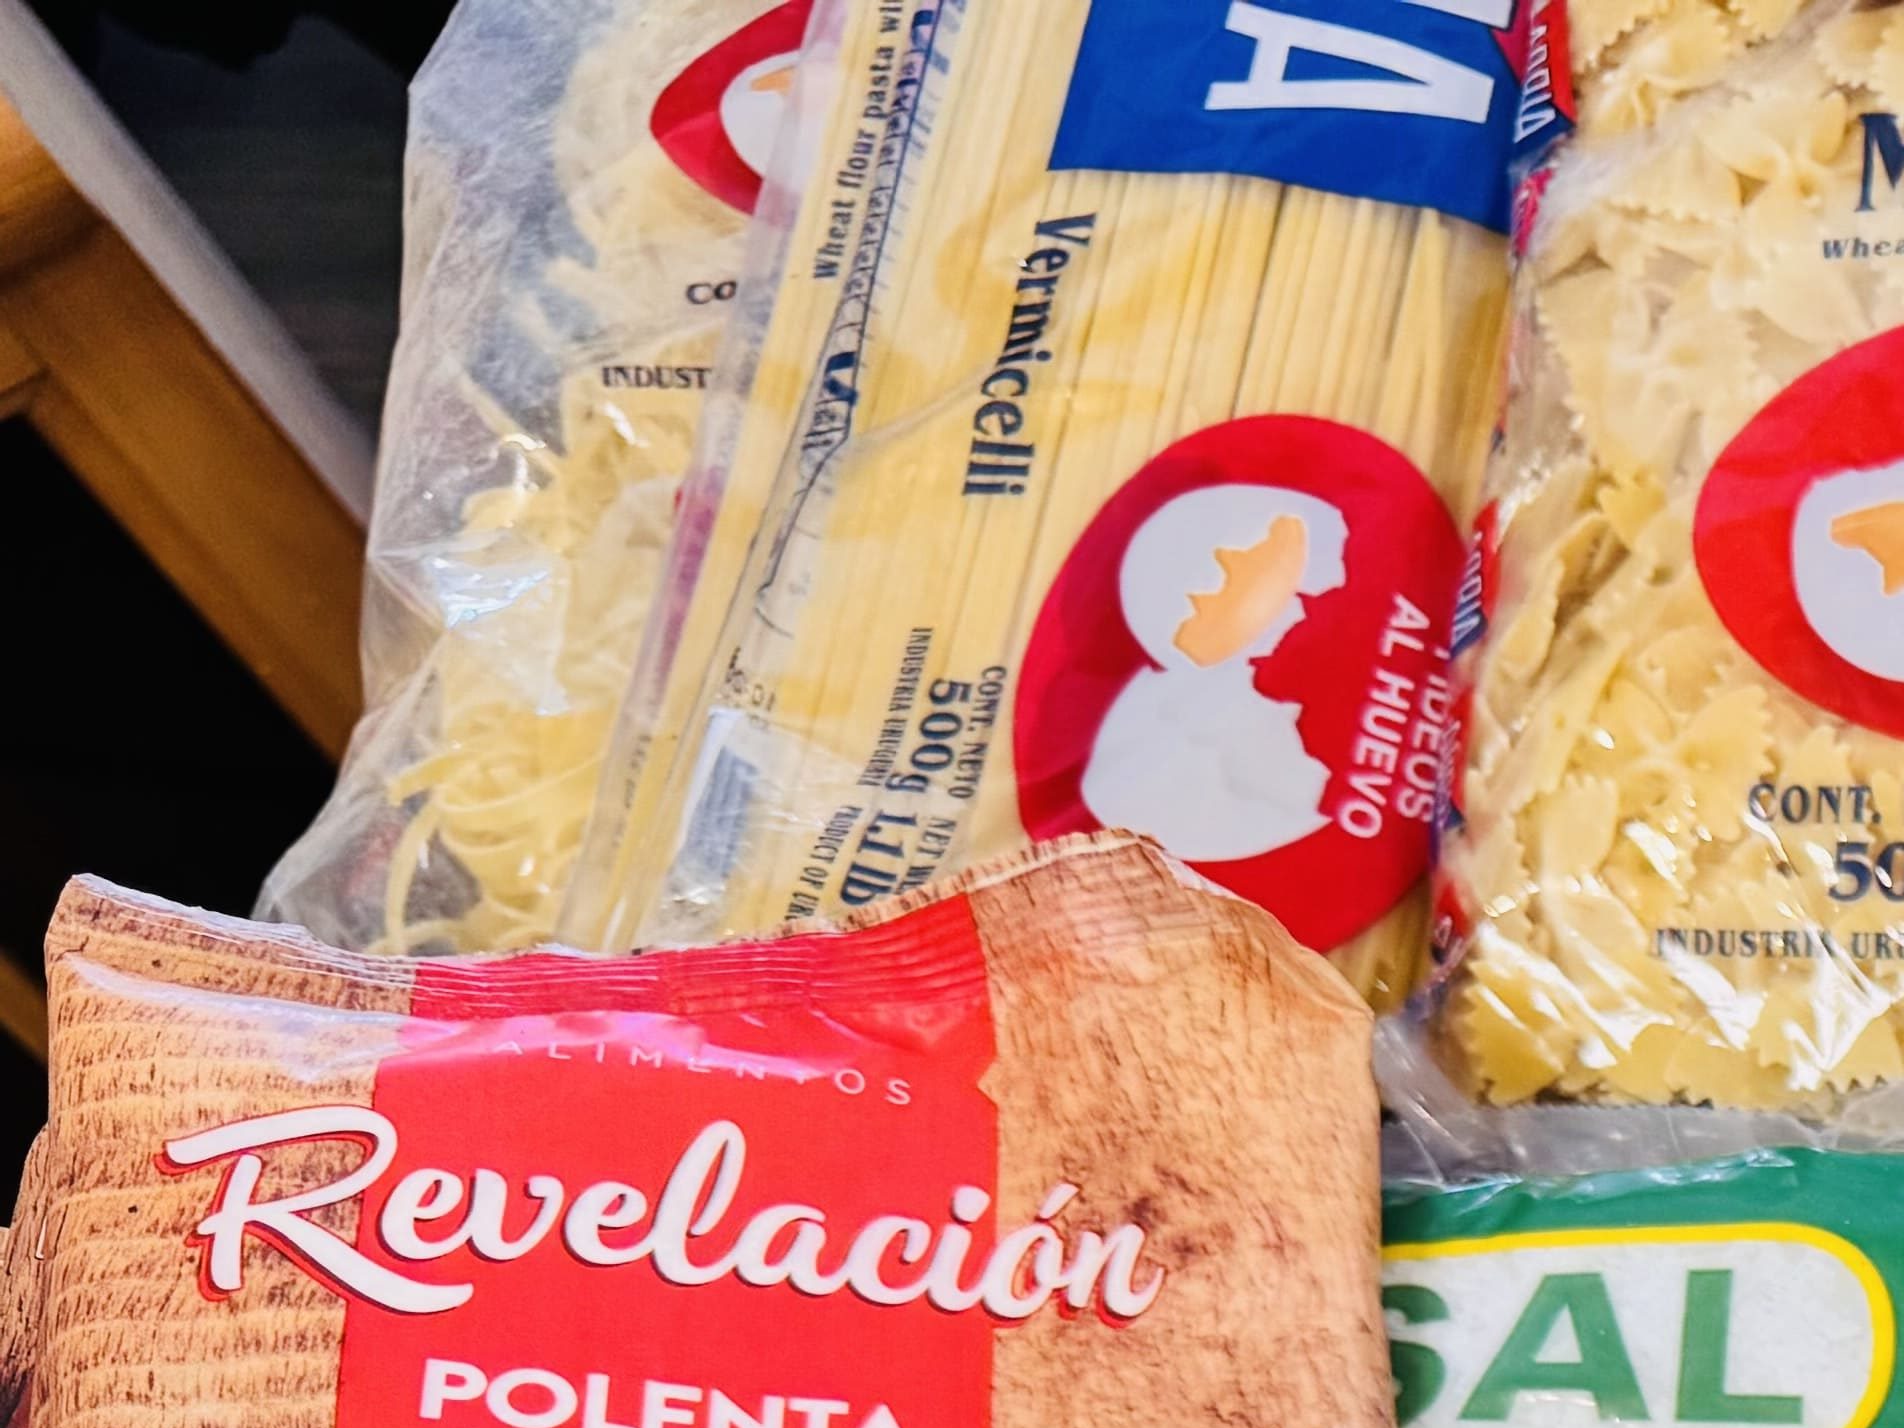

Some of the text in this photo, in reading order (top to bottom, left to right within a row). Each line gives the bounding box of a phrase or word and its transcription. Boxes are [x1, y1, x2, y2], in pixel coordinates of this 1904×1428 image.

[814, 200, 856, 279] Wheat
[837, 129, 876, 189] flour
[864, 46, 898, 119] pasta
[961, 210, 1098, 500] Vermicelli
[889, 627, 932, 713] INDUSTRIA
[967, 665, 1007, 732] CONT.
[885, 678, 972, 793] 500g
[1336, 592, 1431, 839] AL HUEVO
[948, 742, 988, 799] NETO
[811, 805, 863, 862] PRODUCT
[857, 809, 918, 859] 1.1
[1748, 781, 1881, 828] CONT.
[916, 817, 957, 860] NET
[800, 866, 829, 890] OF
[840, 862, 898, 905] lb
[1655, 926, 1836, 961] INDUSTRIA
[159, 1101, 1164, 1325] Revelación
[1383, 1267, 1804, 1428] SAL
